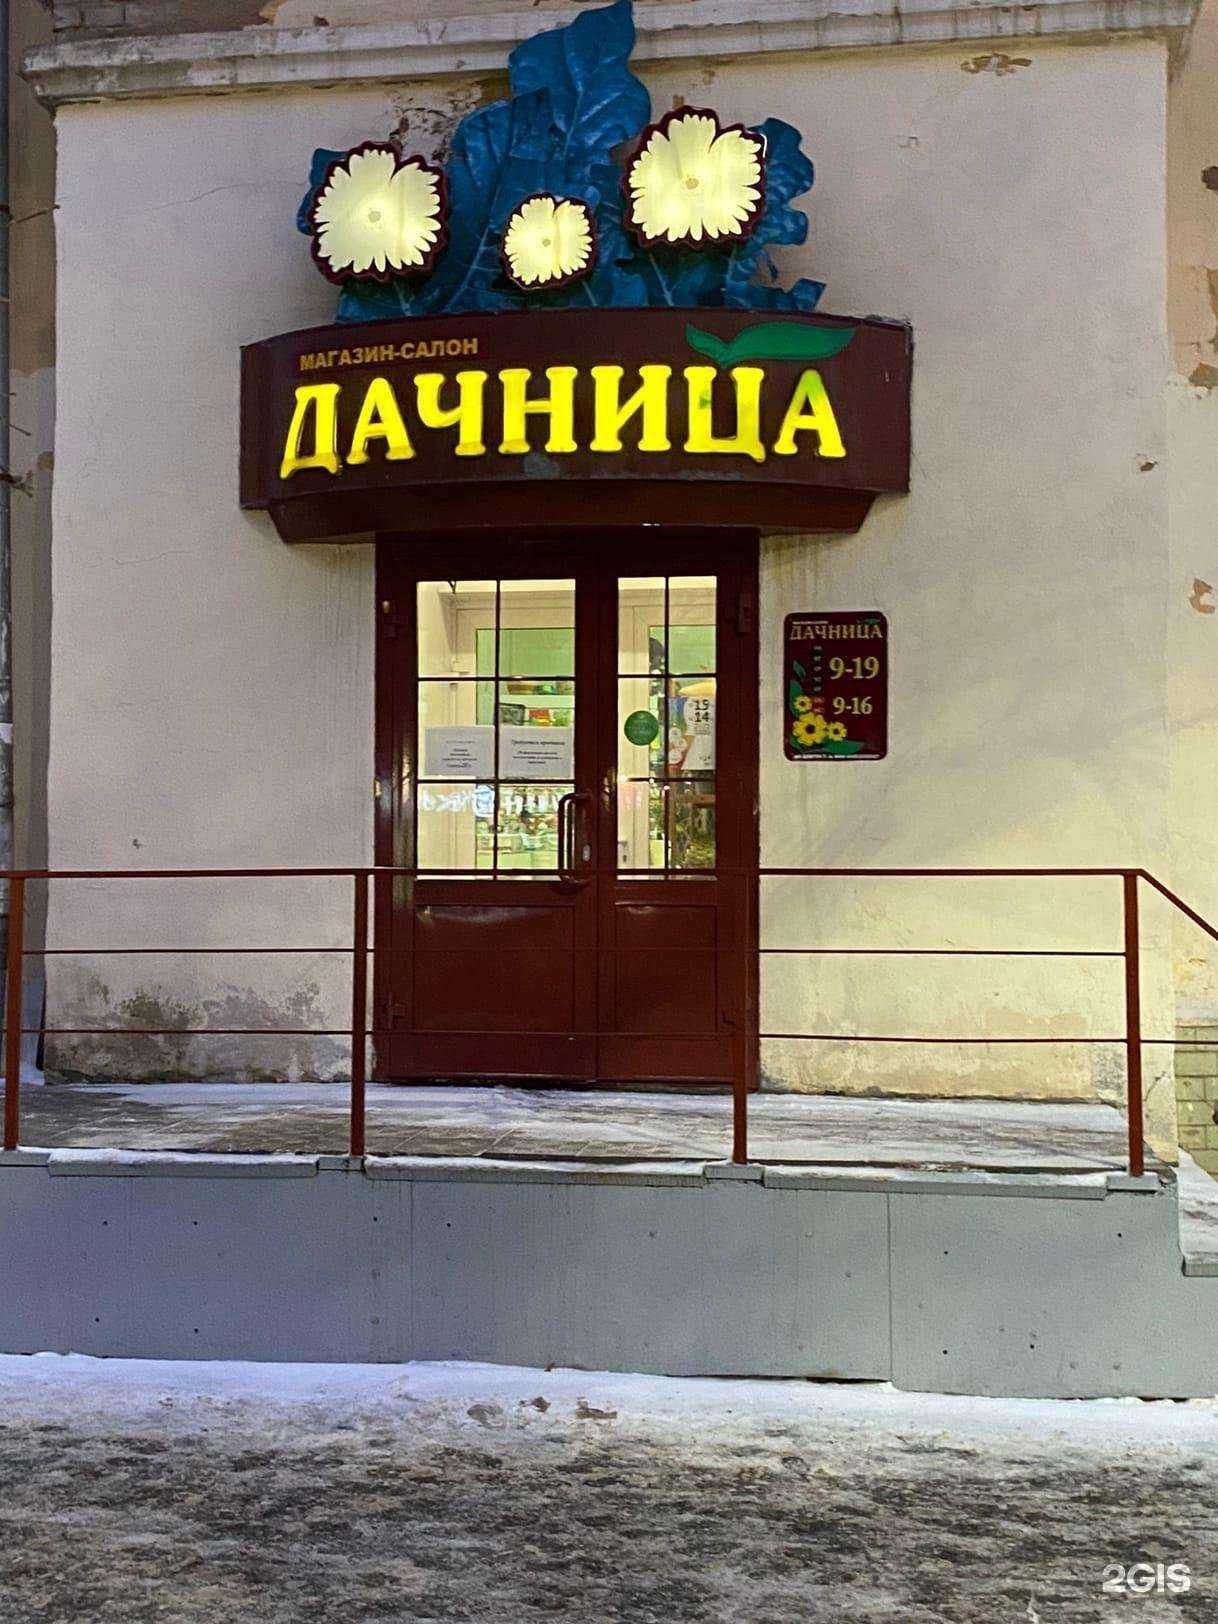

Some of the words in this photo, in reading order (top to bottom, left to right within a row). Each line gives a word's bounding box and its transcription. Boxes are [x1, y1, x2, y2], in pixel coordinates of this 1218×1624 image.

[299, 337, 478, 371] МАГАЗИН-САЛОН
[279, 364, 847, 479] ДАЧНИЦА
[790, 624, 883, 640] ДАЧНИЦА
[829, 656, 880, 679] 9-19
[832, 696, 873, 715] 9-16
